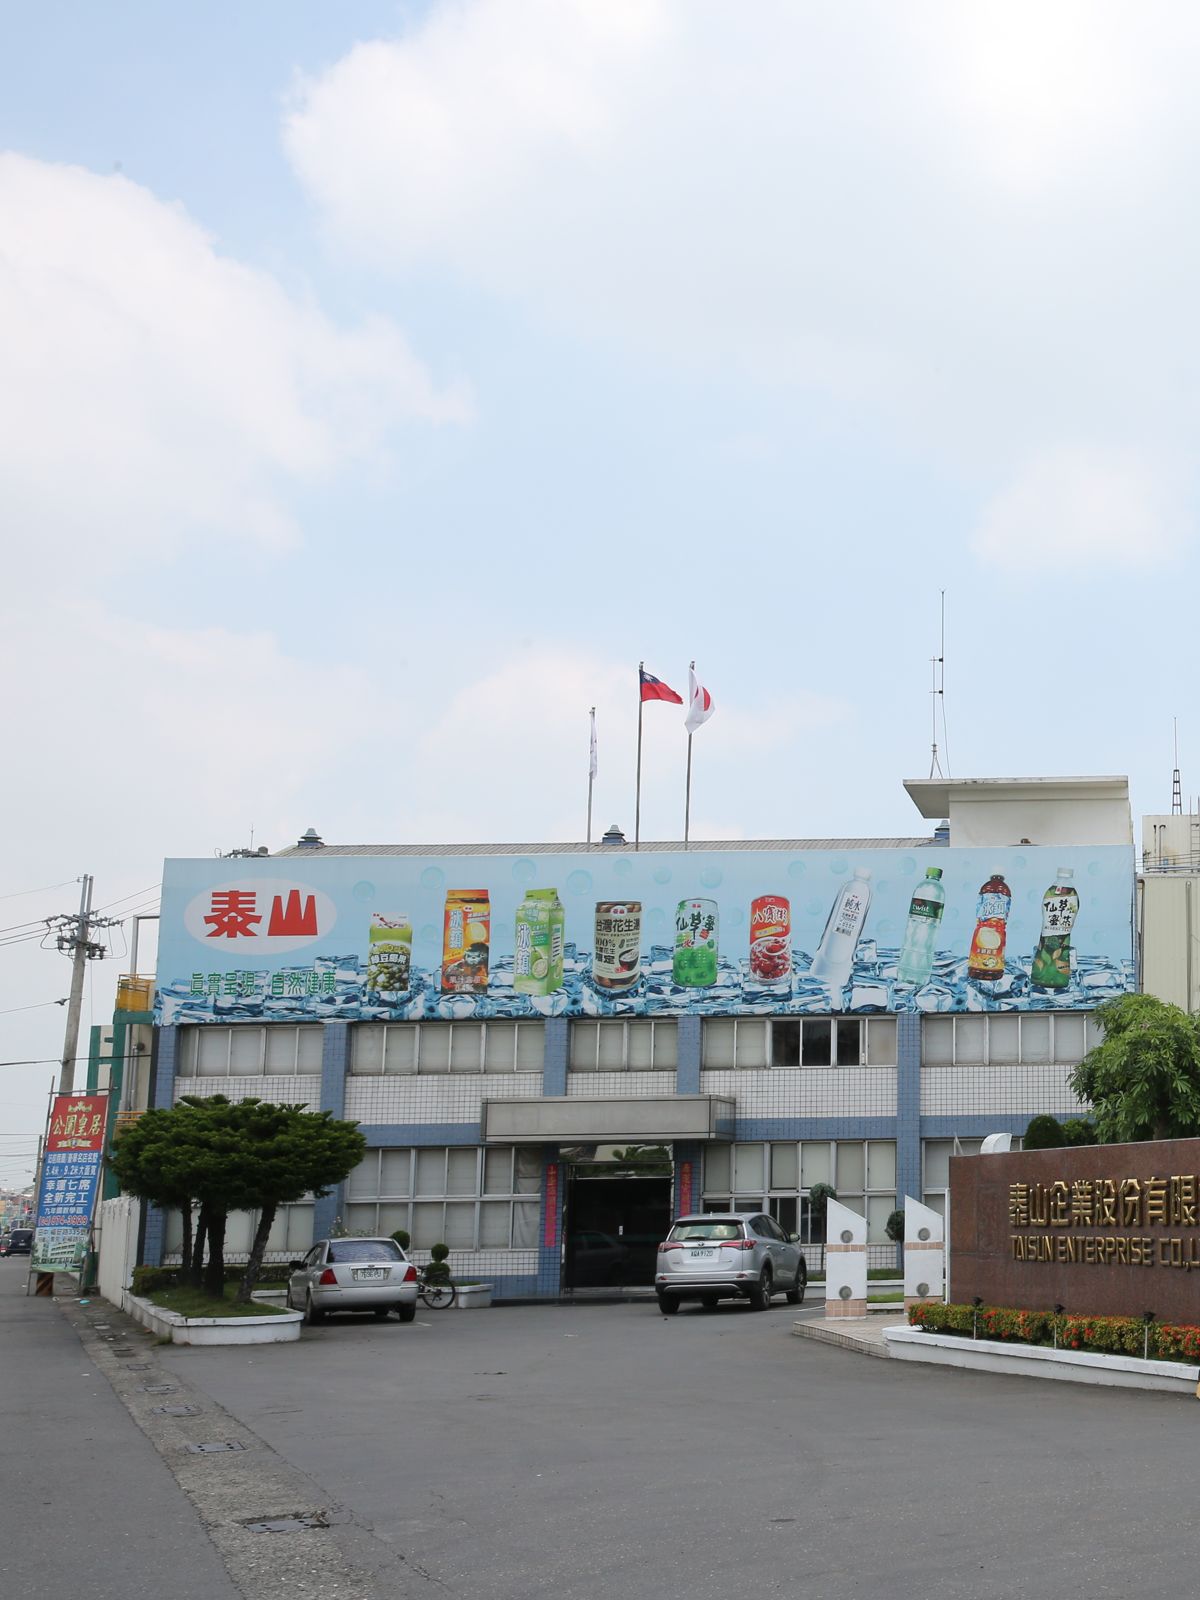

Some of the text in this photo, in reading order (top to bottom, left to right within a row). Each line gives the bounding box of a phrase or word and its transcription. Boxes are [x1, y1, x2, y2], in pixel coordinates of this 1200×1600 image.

[203, 889, 317, 938] 泰山
[676, 911, 715, 940] 仙草蜜
[271, 972, 336, 995] 自然健康
[53, 1114, 102, 1136] 公園皇居
[43, 1192, 88, 1204] 全新完工
[1009, 1234, 1053, 1261] TAISUN
[1056, 1235, 1153, 1266] ENTERPRISE
